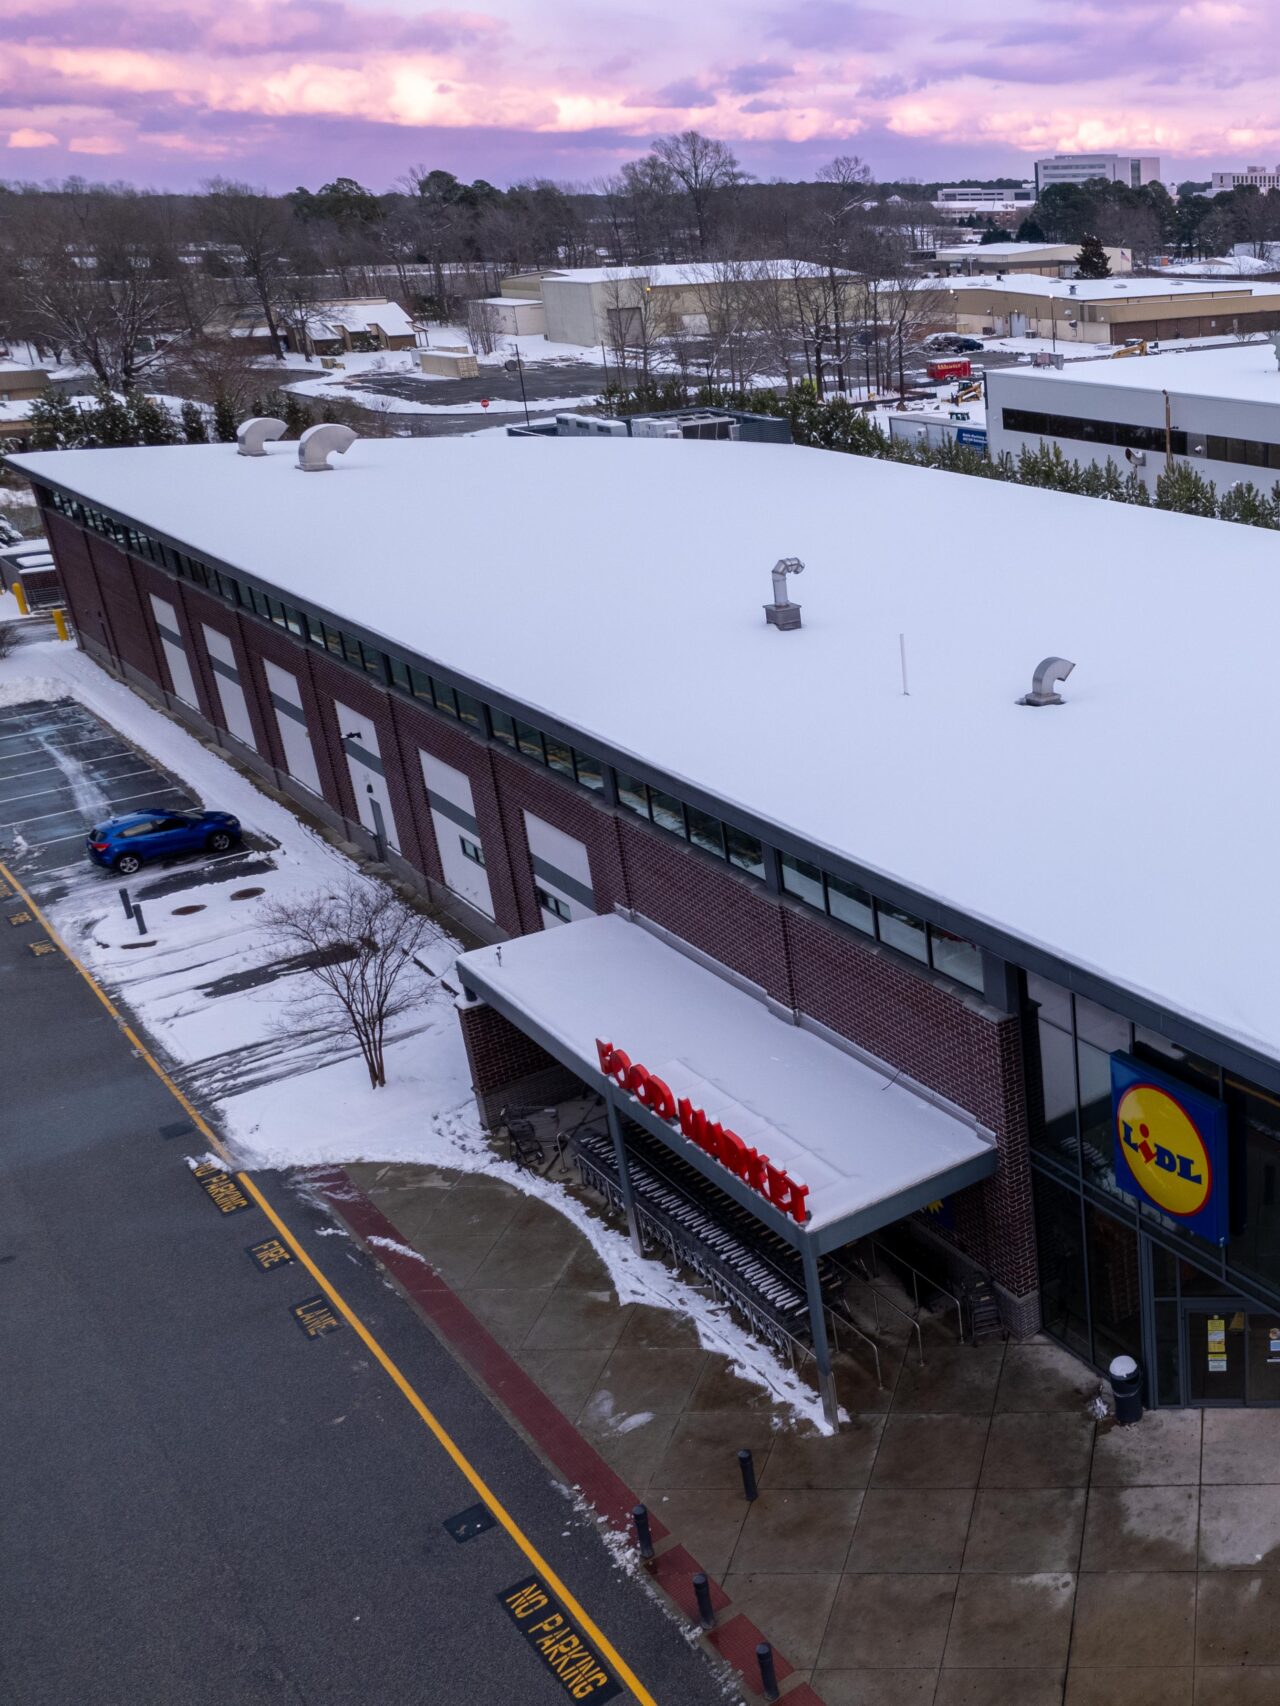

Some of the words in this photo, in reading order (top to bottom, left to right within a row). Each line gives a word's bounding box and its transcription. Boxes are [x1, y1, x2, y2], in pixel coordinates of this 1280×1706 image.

[595, 1036, 676, 1121] FOOD
[201, 1173, 248, 1213] PARKING
[251, 1239, 291, 1269] FIRE
[295, 1299, 338, 1336] LANE
[505, 1583, 549, 1619] NO
[528, 1612, 608, 1699] PARKING
